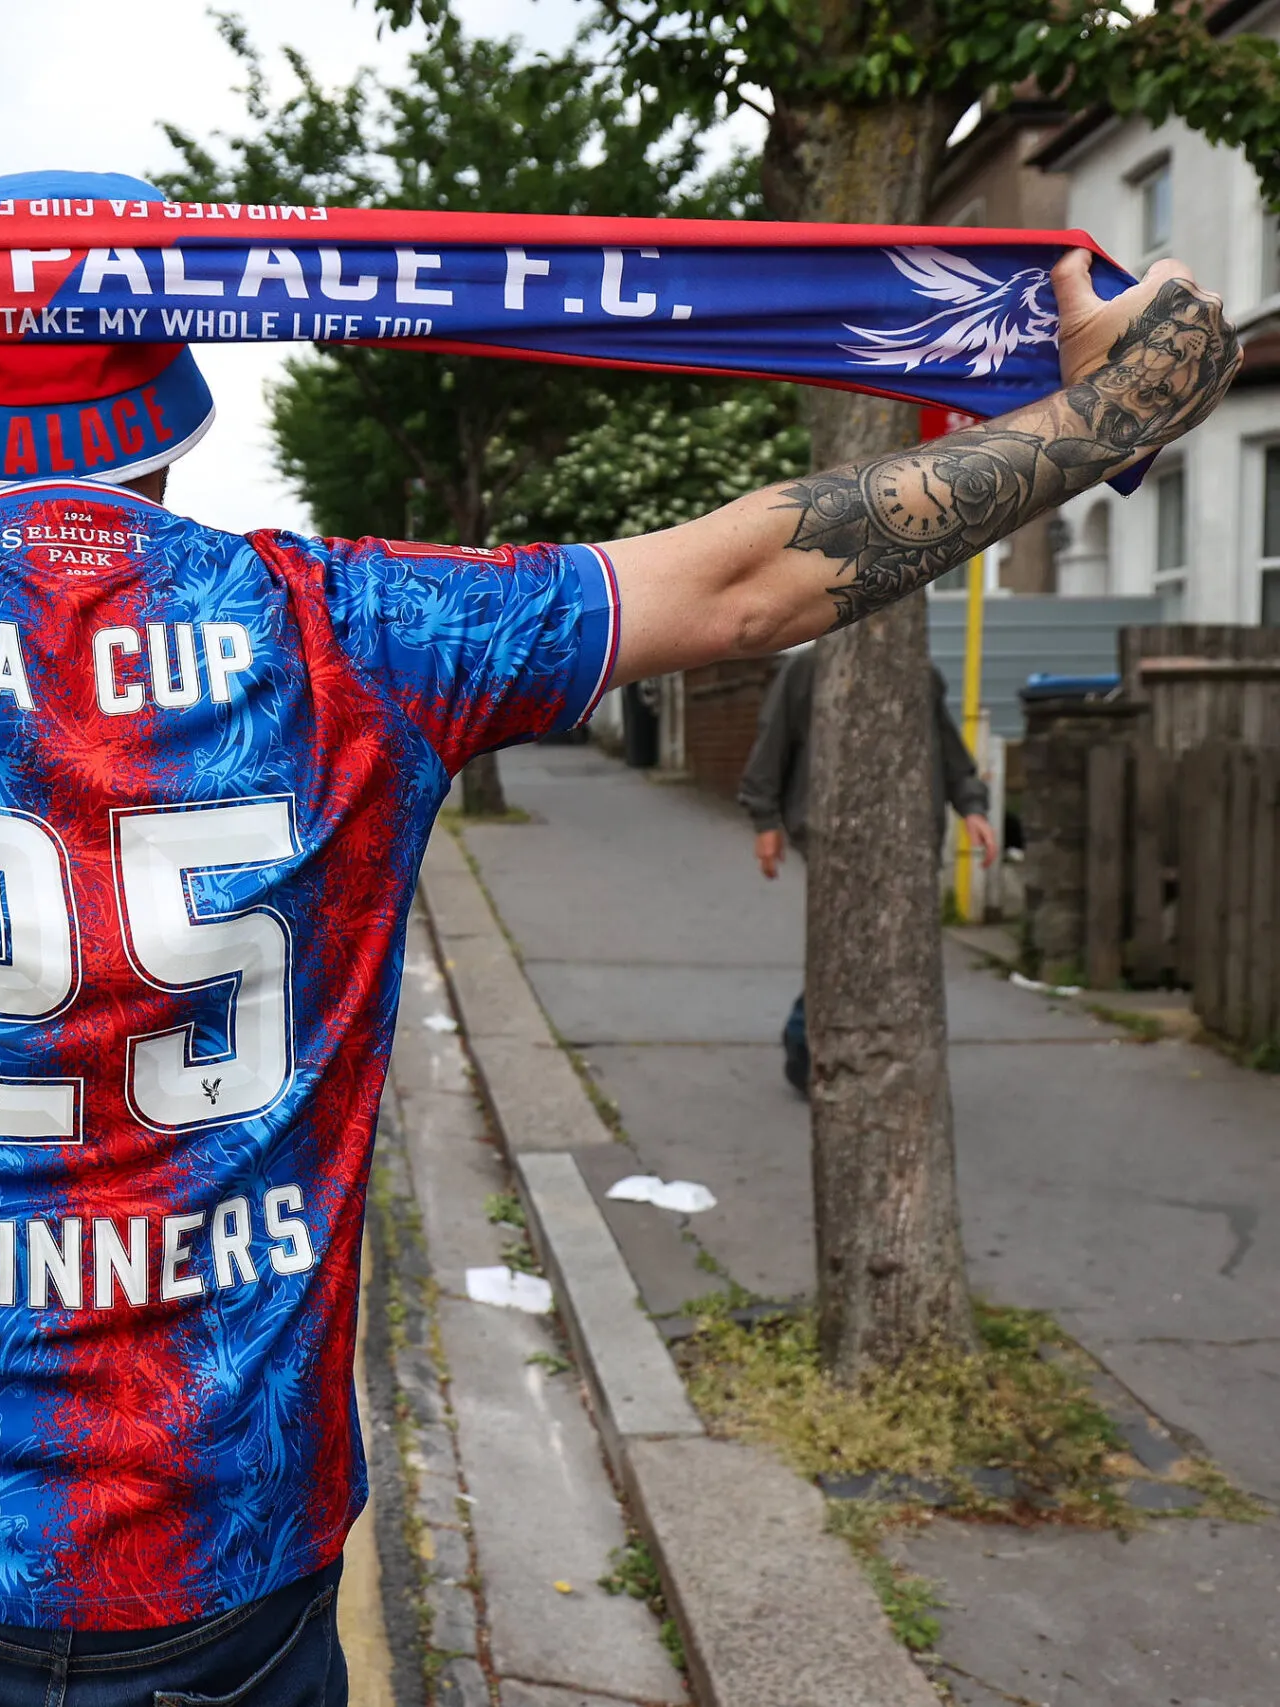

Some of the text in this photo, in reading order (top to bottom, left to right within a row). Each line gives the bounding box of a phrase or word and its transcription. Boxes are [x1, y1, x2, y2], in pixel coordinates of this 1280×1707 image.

[10, 246, 453, 306] PALACE
[503, 246, 693, 320] F.C.
[98, 307, 149, 336] MY
[160, 308, 280, 340] WHOLE
[292, 312, 363, 341] LIFE
[63, 511, 93, 523] 1924
[1, 526, 151, 554] SELHURST
[47, 548, 113, 567] PARK
[66, 568, 97, 576] 2024
[91, 621, 254, 717] CUP
